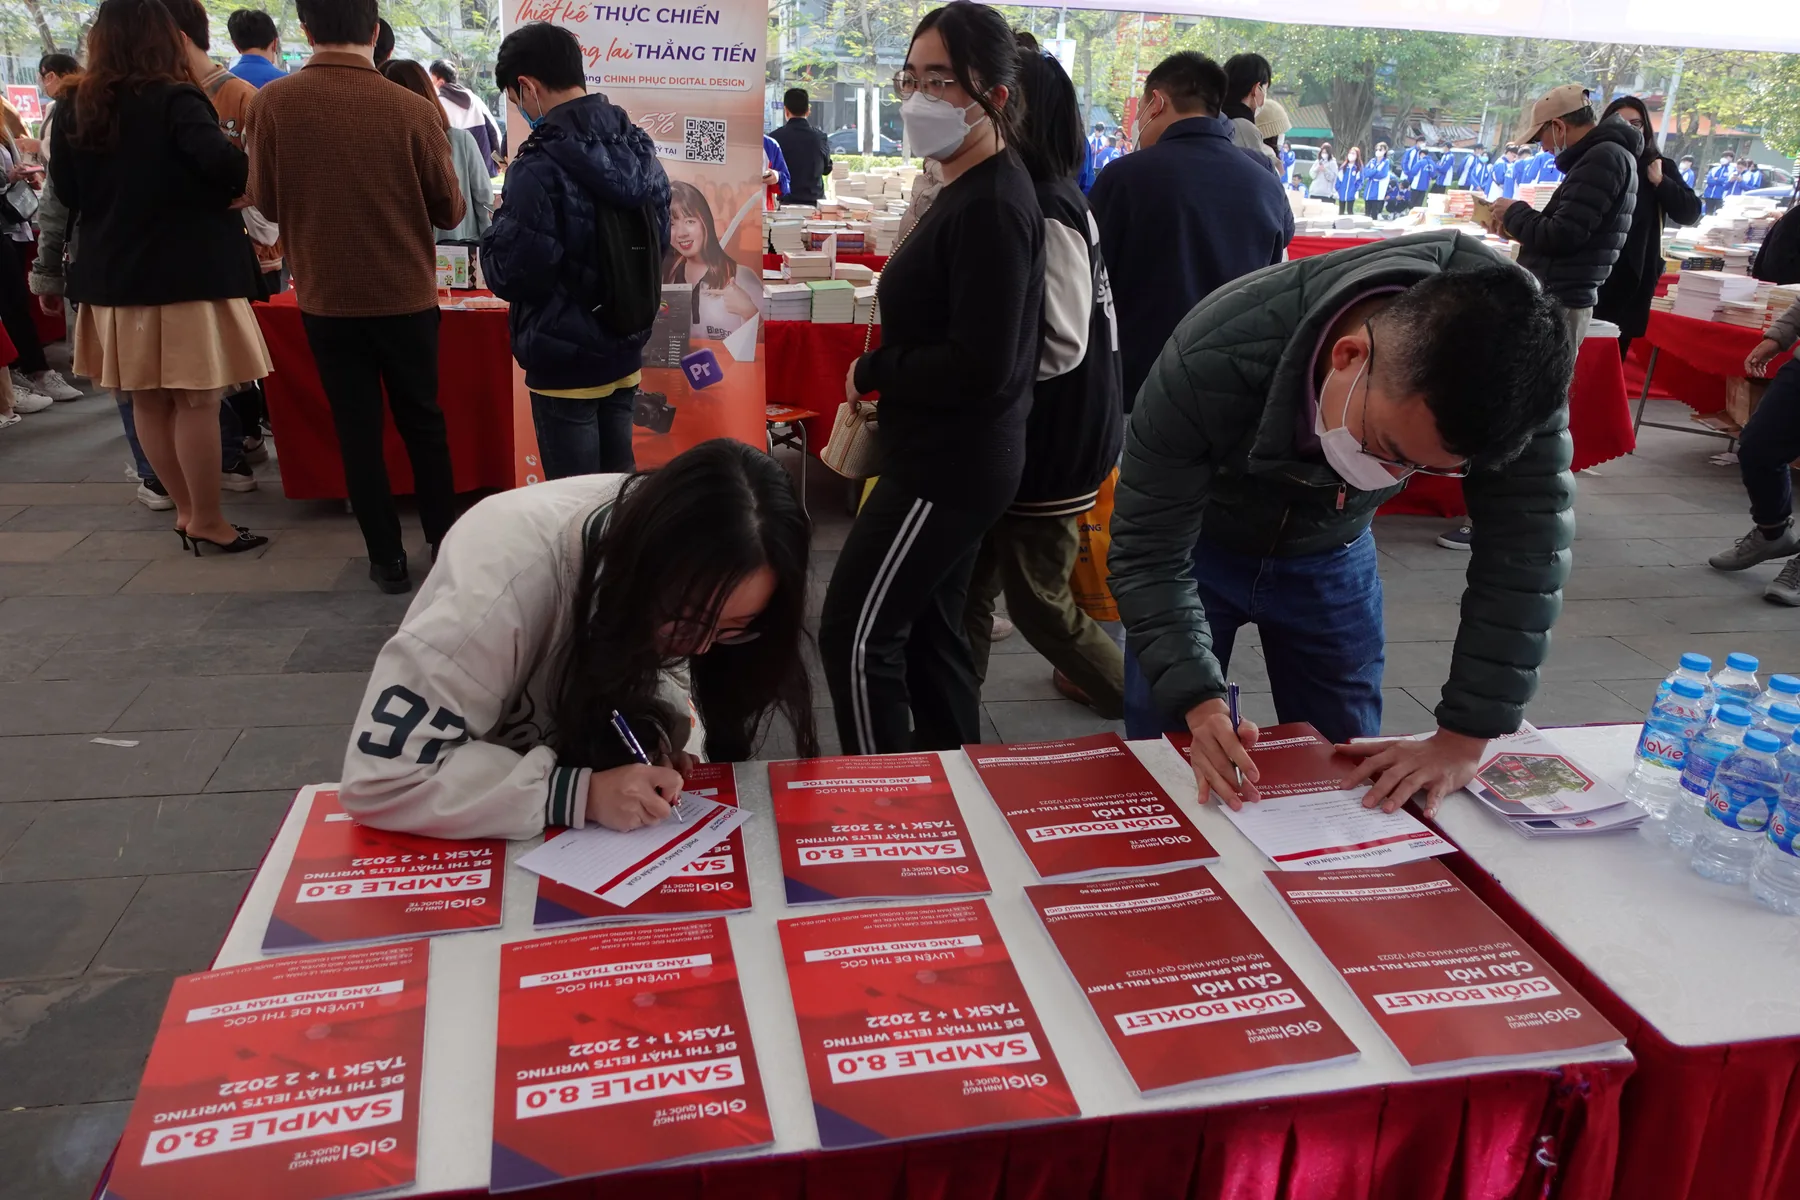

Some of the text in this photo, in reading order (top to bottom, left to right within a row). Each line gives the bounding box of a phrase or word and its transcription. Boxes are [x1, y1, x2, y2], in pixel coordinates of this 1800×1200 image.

[562, 1, 590, 23] kế
[594, 5, 650, 26] THỰC
[656, 3, 721, 25] CHIẾN
[606, 37, 633, 61] lai
[635, 38, 706, 62] THẲNG
[713, 41, 757, 63] TIẾN
[603, 75, 636, 83] CHINH
[638, 76, 667, 86] PHỤC
[668, 77, 706, 86] DIGITAL
[709, 78, 746, 87] DESIGN
[688, 359, 710, 380] Pr
[357, 684, 469, 764] 97
[1643, 736, 1684, 760] laVie
[1082, 799, 1125, 808] SPEAKING
[1006, 808, 1029, 816] PART
[1091, 803, 1165, 819] CÂU HỎI
[831, 823, 870, 833] 2022
[873, 823, 884, 831] 2
[900, 822, 908, 830] 1
[910, 820, 954, 830] TASK
[1035, 817, 1174, 838] CUỐN BOOKLET
[795, 835, 849, 844] WRITING
[885, 832, 917, 840] THẬT
[432, 852, 440, 861] 1
[444, 848, 493, 860] TASK
[805, 843, 956, 861] SAMPLE 8.0
[351, 855, 396, 867] 2022
[400, 854, 412, 863] 2
[369, 866, 405, 875] IELTS
[408, 863, 444, 872] THẬT
[447, 861, 470, 869] THI
[303, 869, 365, 880] WRITING
[306, 873, 482, 897] SAMPLE 8.0
[890, 941, 927, 950] BAND
[1498, 949, 1521, 958] ĐÁP
[871, 956, 892, 965] THI
[1249, 961, 1272, 970] ĐÁP
[1376, 962, 1404, 971] FULL
[1403, 960, 1431, 968] IELTS
[1430, 955, 1481, 966] SPEAKING
[1179, 967, 1232, 980] SPEAKING
[1231, 964, 1247, 972] ÁN
[1342, 965, 1369, 974] PART
[1444, 960, 1534, 984] CÂU HỎI
[1123, 978, 1151, 987] FULL
[1151, 974, 1179, 984] IELTS
[1191, 972, 1282, 998] CÂU HỎI
[1087, 983, 1115, 994] PART
[1385, 980, 1550, 1009] CUỐN BOOKLET
[865, 1002, 1020, 1028] TASK 1 + 2 2022
[1126, 992, 1296, 1029] CUỐN BOOKLET
[936, 1023, 975, 1036] THẬT
[976, 1021, 1002, 1031] THI
[892, 1027, 932, 1040] IELTS
[568, 1024, 735, 1057] TASK 1 + 2 2022
[823, 1032, 890, 1048] WRITING
[639, 1048, 683, 1063] THẬT
[685, 1045, 712, 1056] THI
[593, 1054, 636, 1069] IELTS
[837, 1039, 1027, 1075] SAMPLE 8.0
[218, 1055, 406, 1096] TASK 1 + 2 2022
[516, 1061, 589, 1080] WRITING
[347, 1079, 376, 1092] THI
[525, 1063, 733, 1109] SAMPLE 8.0
[294, 1085, 342, 1100] THẬT
[242, 1092, 291, 1108] IELTS
[153, 1101, 236, 1123] WRITING
[155, 1099, 392, 1154] SAMPLE 8.0
